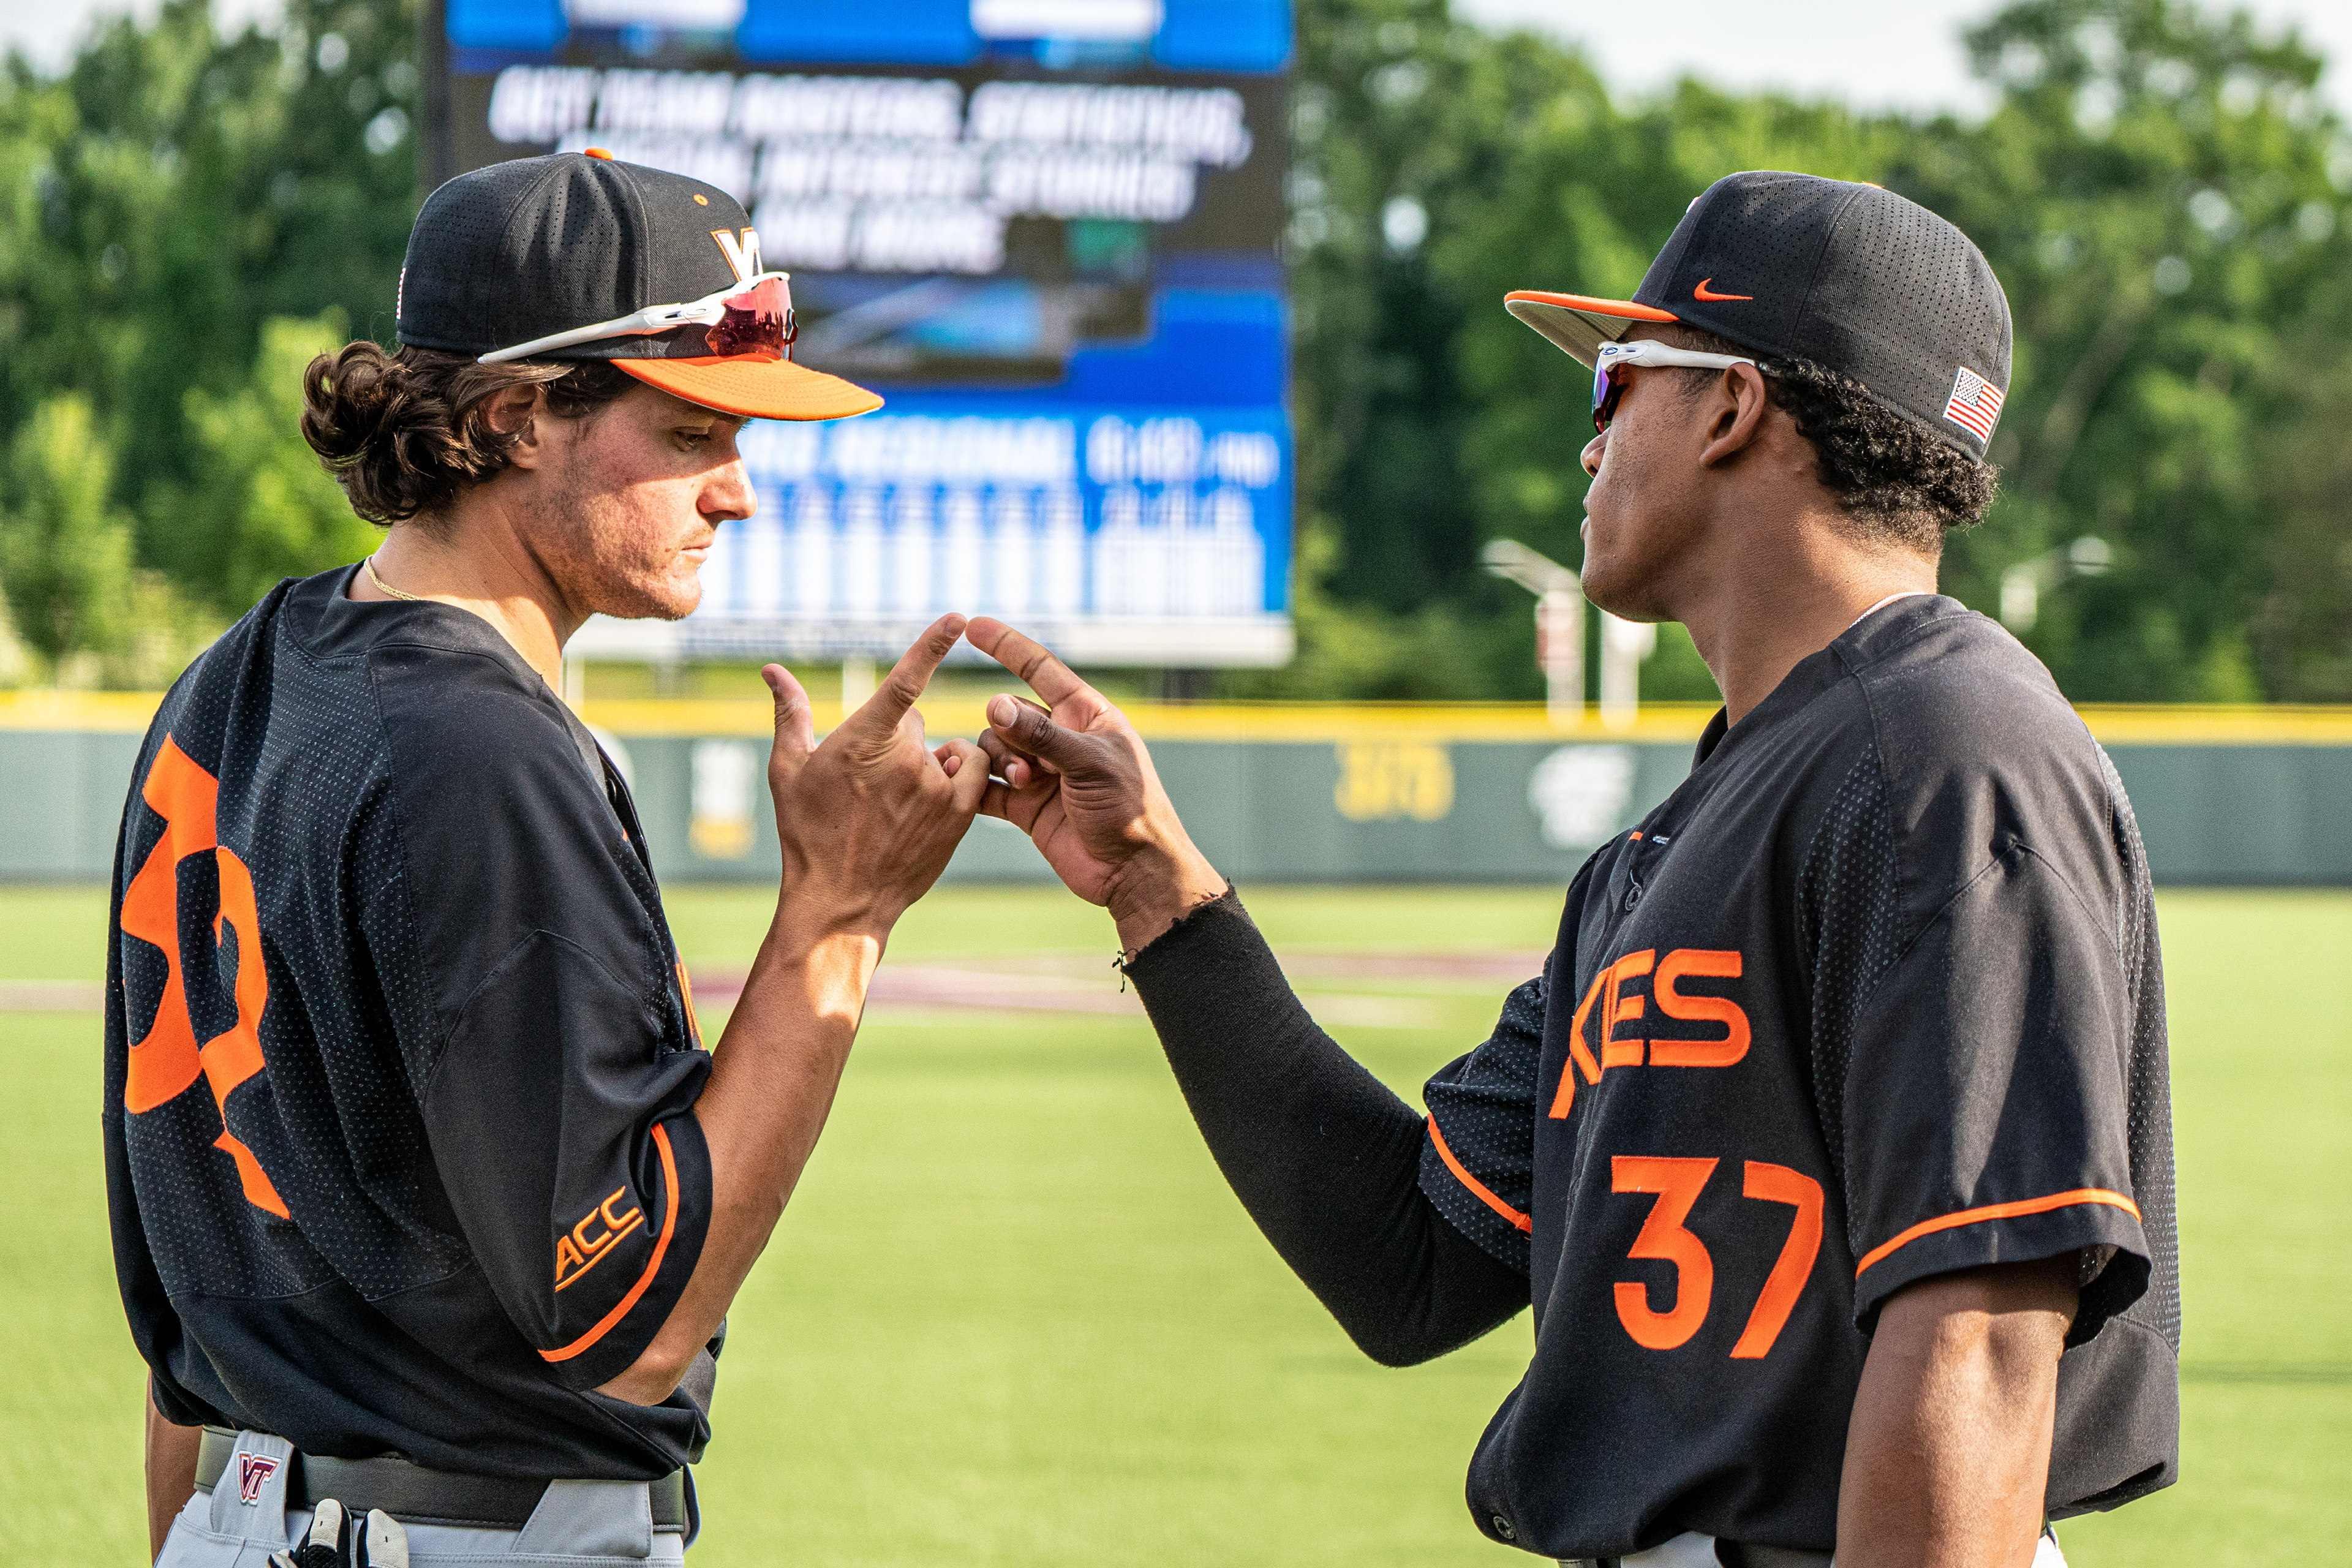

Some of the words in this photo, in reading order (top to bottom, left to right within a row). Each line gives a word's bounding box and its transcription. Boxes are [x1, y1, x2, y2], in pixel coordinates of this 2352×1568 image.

[555, 1185, 640, 1282] ACC
[1611, 1155, 1825, 1358] 37
[238, 1451, 281, 1504] VT
